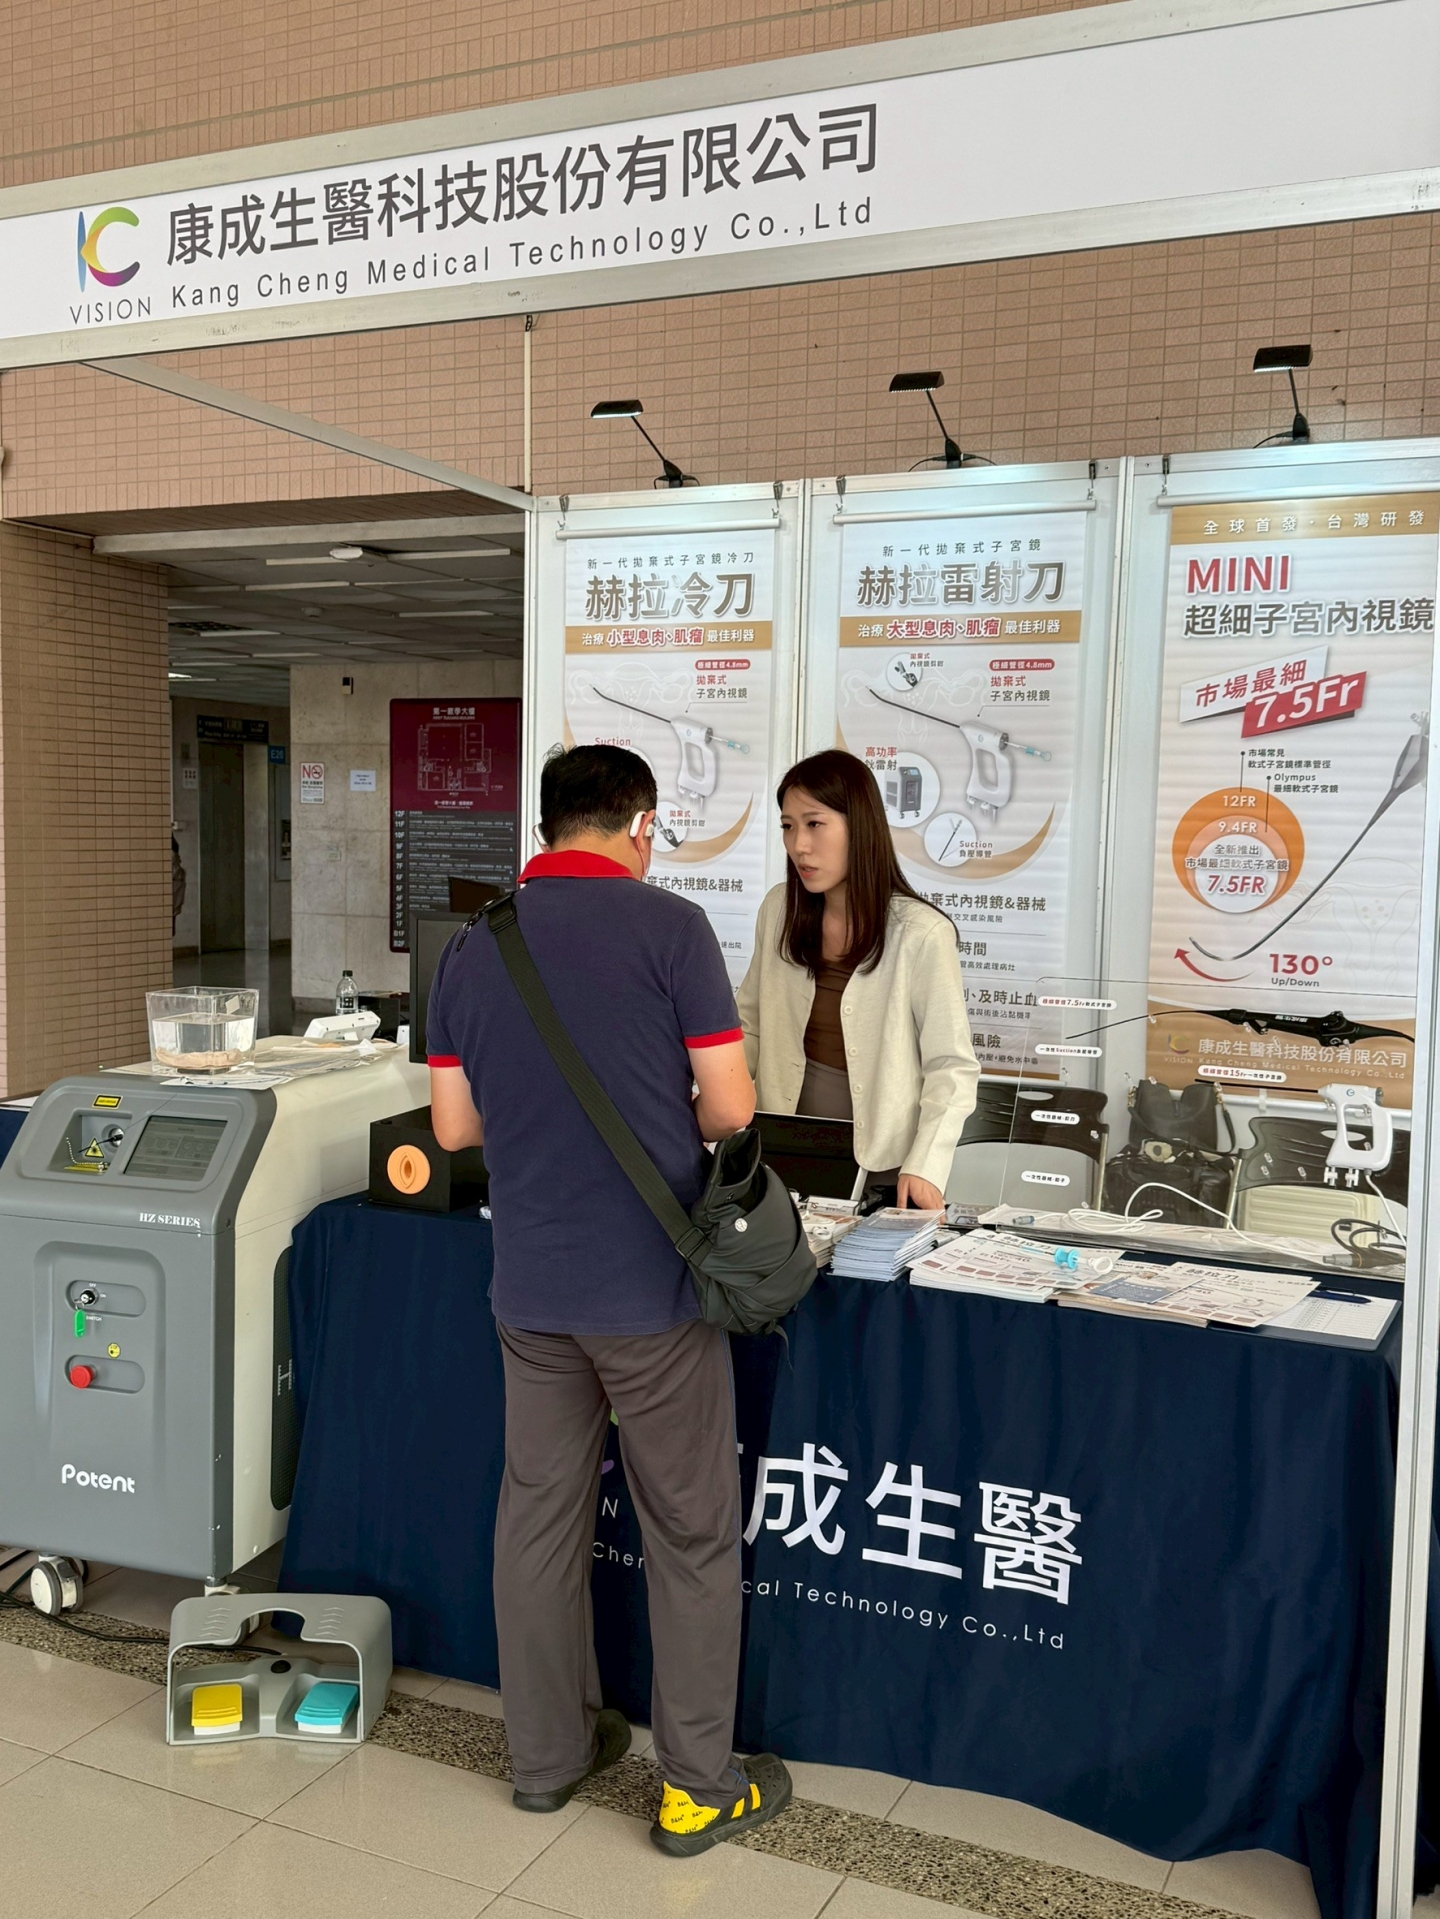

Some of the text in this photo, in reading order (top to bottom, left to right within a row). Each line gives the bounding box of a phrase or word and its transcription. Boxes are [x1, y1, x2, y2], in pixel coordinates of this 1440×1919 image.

[166, 103, 877, 266] 康成生醫科技股份有限公司
[172, 196, 872, 309] Kang Cheng Medical Technology Co.,Ltd
[69, 297, 152, 325] VISION
[882, 539, 1042, 558] 新一代拋棄式子宮鏡
[587, 552, 754, 570] 新一代拋棄式子宮鏡冷刀
[1187, 555, 1290, 594] MINI
[857, 560, 1065, 606] 赫拉雷射刀
[585, 572, 755, 620] 赫拉冷刀
[1183, 597, 1434, 637] 超細子宮內視鏡
[990, 675, 1027, 687] 拋棄式
[1195, 658, 1307, 708] 市場最細
[696, 688, 748, 699] 子宮內視鏡
[990, 689, 1051, 702] 子宮內視鏡
[1255, 677, 1360, 729] 7.5Fr
[594, 737, 631, 747] Suction
[865, 746, 898, 758] 高功率
[1248, 749, 1285, 758] 市場常見
[1274, 773, 1316, 782] Olympus
[1223, 796, 1256, 807] 12FR
[1218, 821, 1257, 834] 9.4FR
[959, 840, 993, 849] Suction
[1214, 844, 1259, 856] 全新推出
[1185, 858, 1289, 872] 市場最細軟式子宮鏡
[1207, 875, 1266, 894] 7.5FR
[958, 941, 987, 957] 時間
[1271, 977, 1320, 988] Up/Down
[972, 1033, 1002, 1049] 風險
[1198, 1037, 1407, 1069] 康成生醫科技股份有限公司
[1305, 1064, 1362, 1077] Technology
[139, 1212, 201, 1227] HZ SERIES
[61, 1463, 136, 1494] Potent
[737, 1442, 1084, 1606] 成生醫
[794, 1582, 949, 1631] Technology
[962, 1615, 1065, 1650] Co.,Ltd
